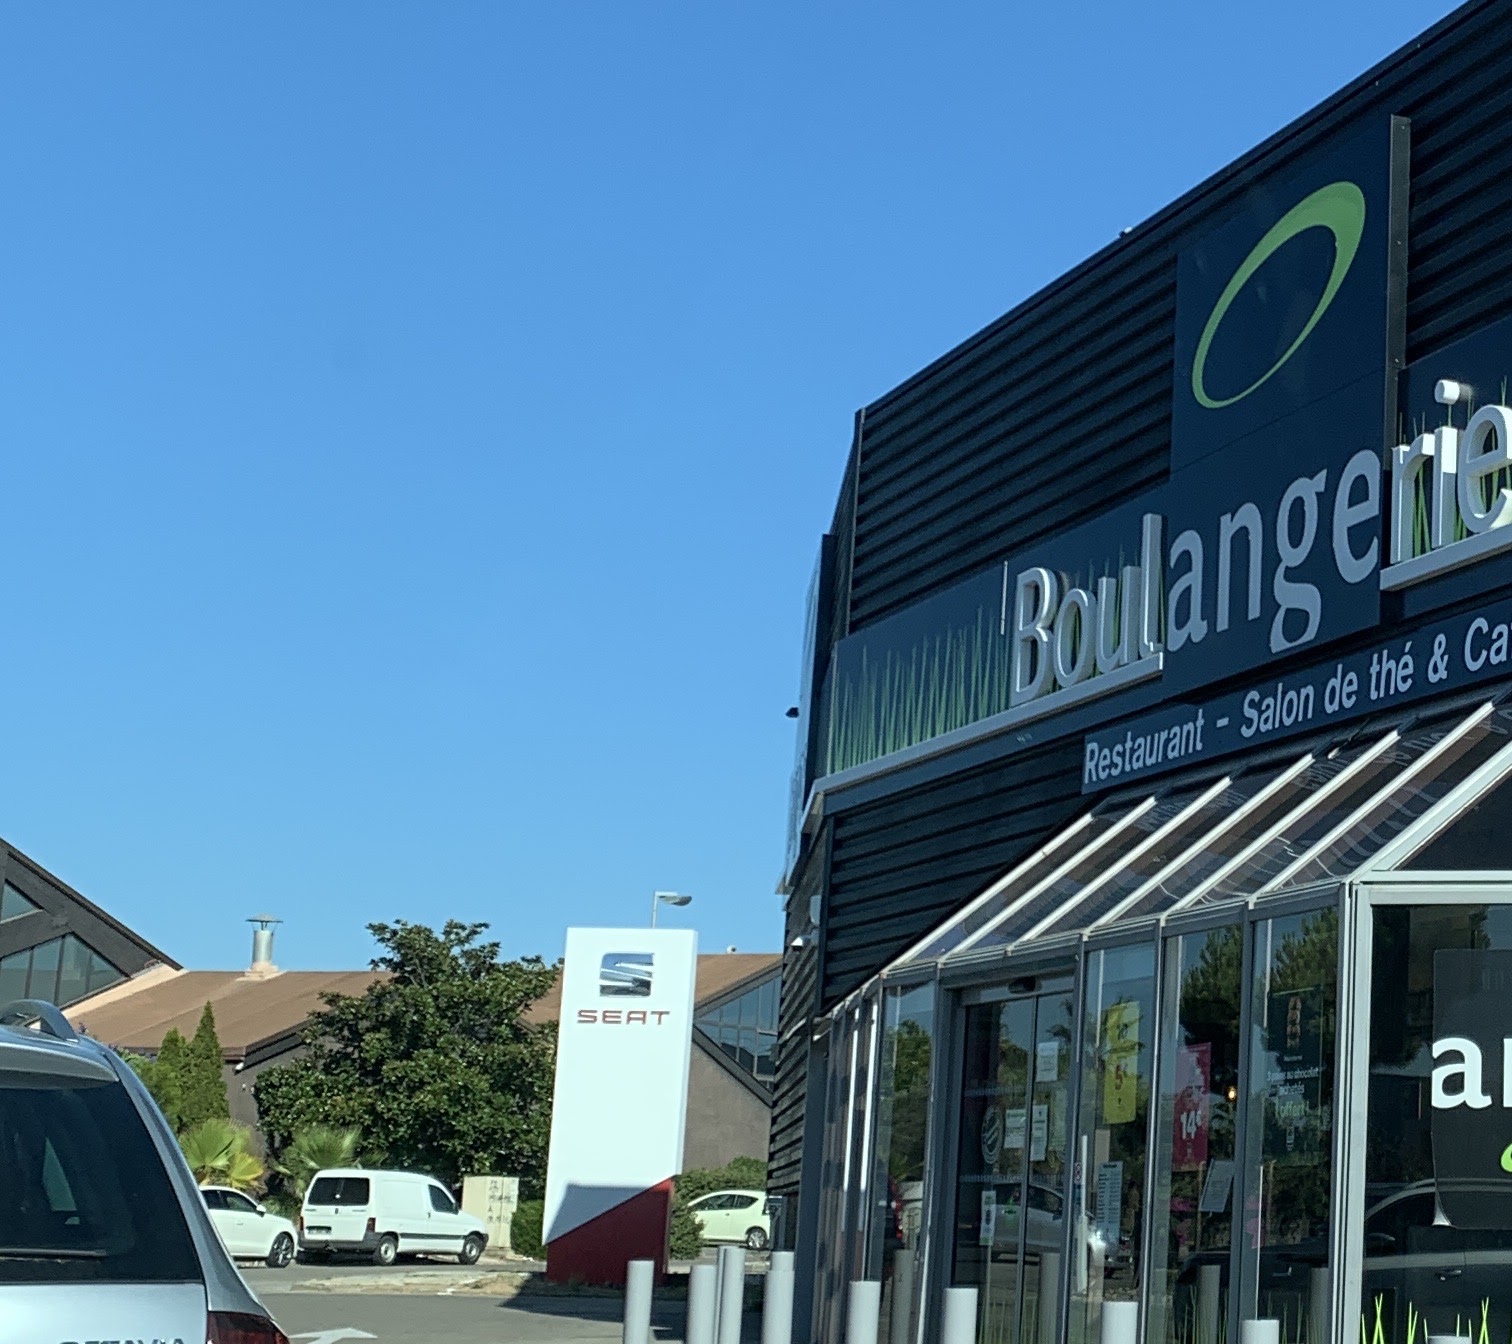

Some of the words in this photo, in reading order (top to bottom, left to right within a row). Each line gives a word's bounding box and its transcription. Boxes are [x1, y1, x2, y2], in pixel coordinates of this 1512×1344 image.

[1084, 709, 1205, 785] Restaurant
[1240, 682, 1315, 738] Salon
[1324, 663, 1359, 714] de
[1369, 640, 1414, 700] thé
[1427, 633, 1449, 684] &
[577, 1009, 670, 1025] SEAT
